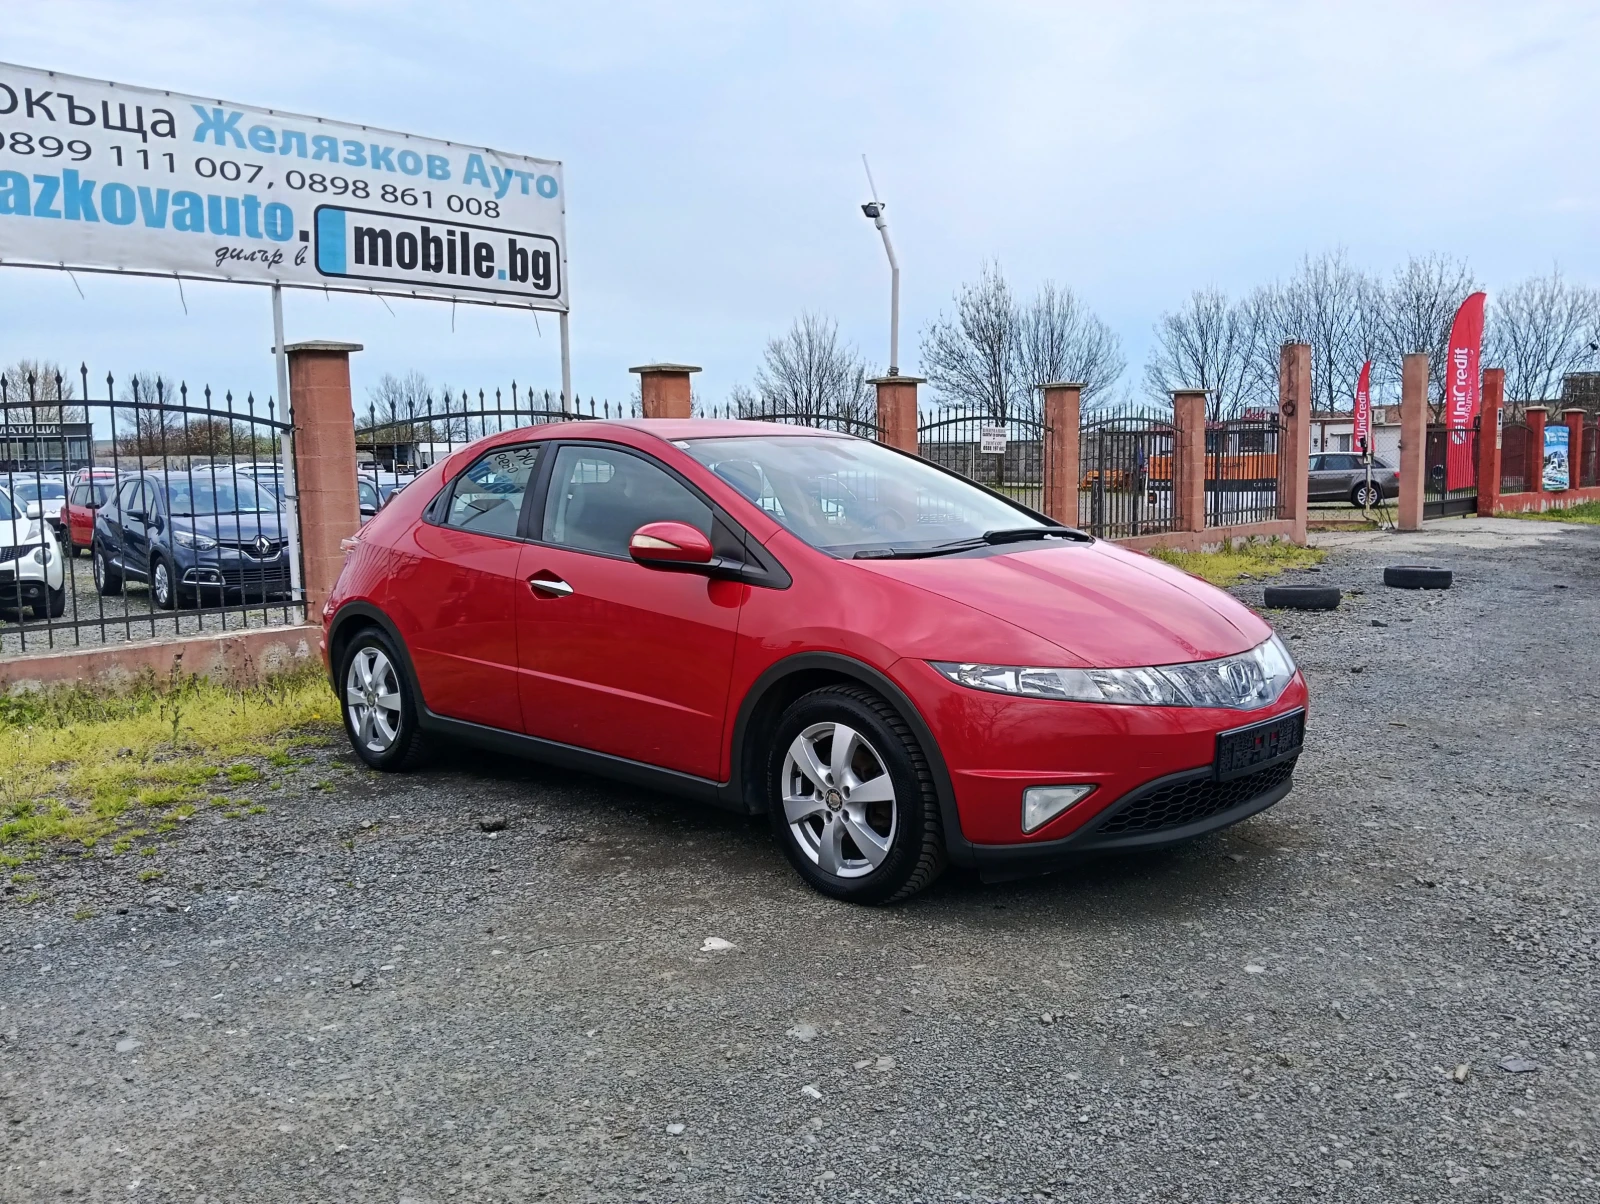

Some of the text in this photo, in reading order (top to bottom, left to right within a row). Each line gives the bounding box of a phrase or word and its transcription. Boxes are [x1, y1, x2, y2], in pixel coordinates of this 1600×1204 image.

[0, 131, 500, 219] 899 111 007, 0898 861 008
[190, 104, 452, 181] Желязков
[462, 153, 559, 200] Ауто
[353, 225, 552, 291] mobile.bg
[1356, 391, 1367, 436] UniCredit
[1452, 347, 1469, 425] UniCredit
